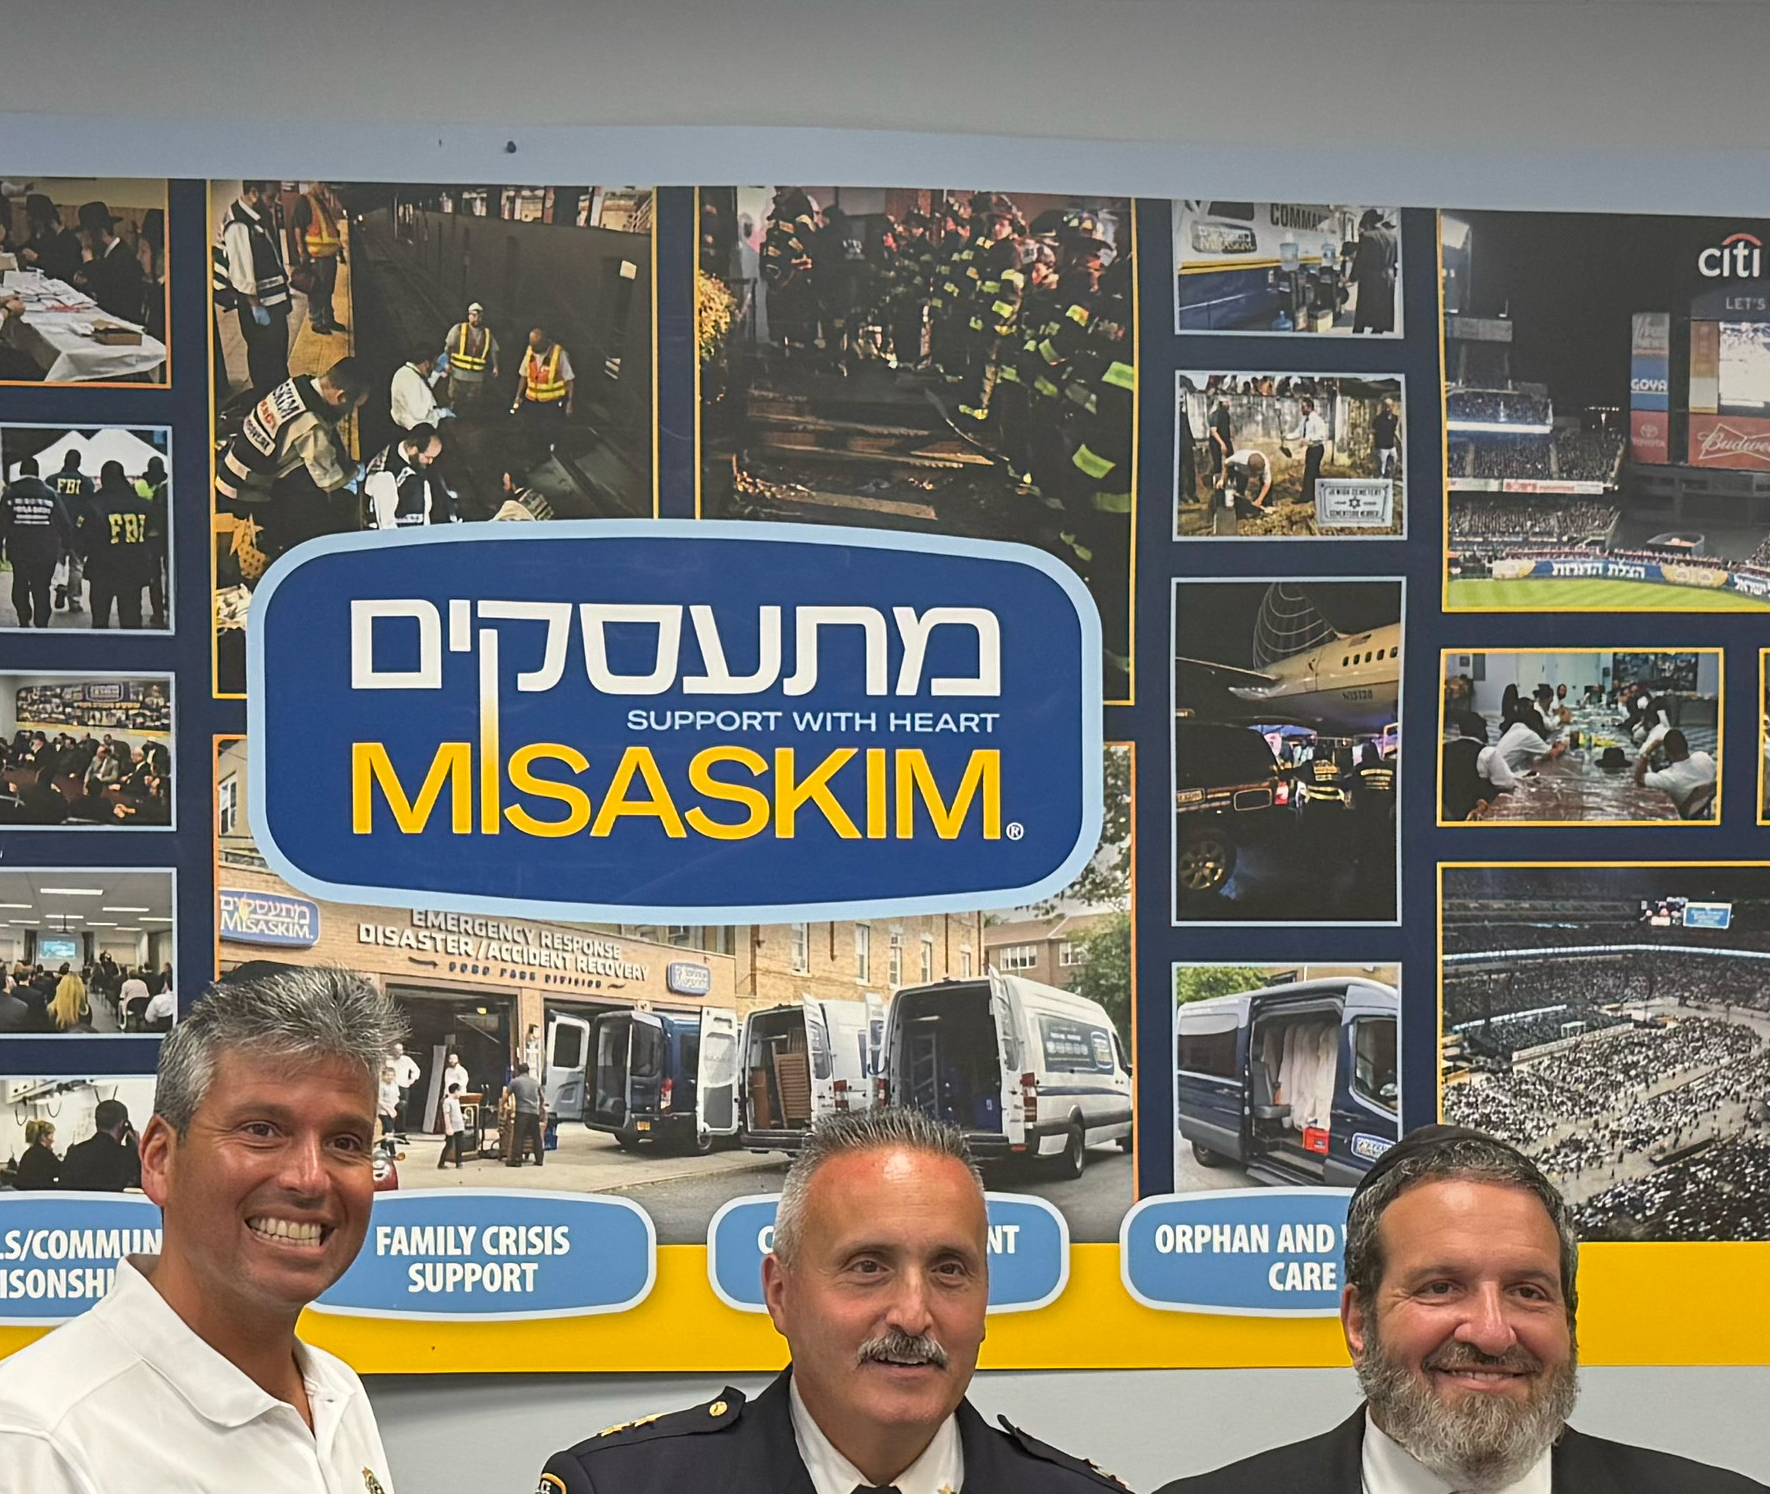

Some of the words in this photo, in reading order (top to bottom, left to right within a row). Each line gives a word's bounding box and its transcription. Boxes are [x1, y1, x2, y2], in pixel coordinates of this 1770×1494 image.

[1698, 238, 1761, 278] citi
[1726, 298, 1765, 311] LET'S
[1631, 379, 1667, 391] GOYA
[56, 478, 81, 494] FBI
[108, 513, 146, 544] FBI
[351, 600, 1001, 697] מתעסקים
[627, 709, 782, 732] SUPPORT
[793, 711, 877, 733] WITH
[890, 712, 1001, 733] HEART
[411, 909, 535, 944] EMERGENCY
[540, 930, 622, 961] RESPONSE
[577, 956, 651, 982] RECOVERY
[376, 1225, 476, 1257] FAMILY
[482, 1225, 570, 1256] CRISIS
[1155, 1224, 1269, 1254] ORPHAN
[1277, 1224, 1335, 1253] AND
[407, 1262, 538, 1293] SUPPORT
[1268, 1262, 1337, 1291] CARE
